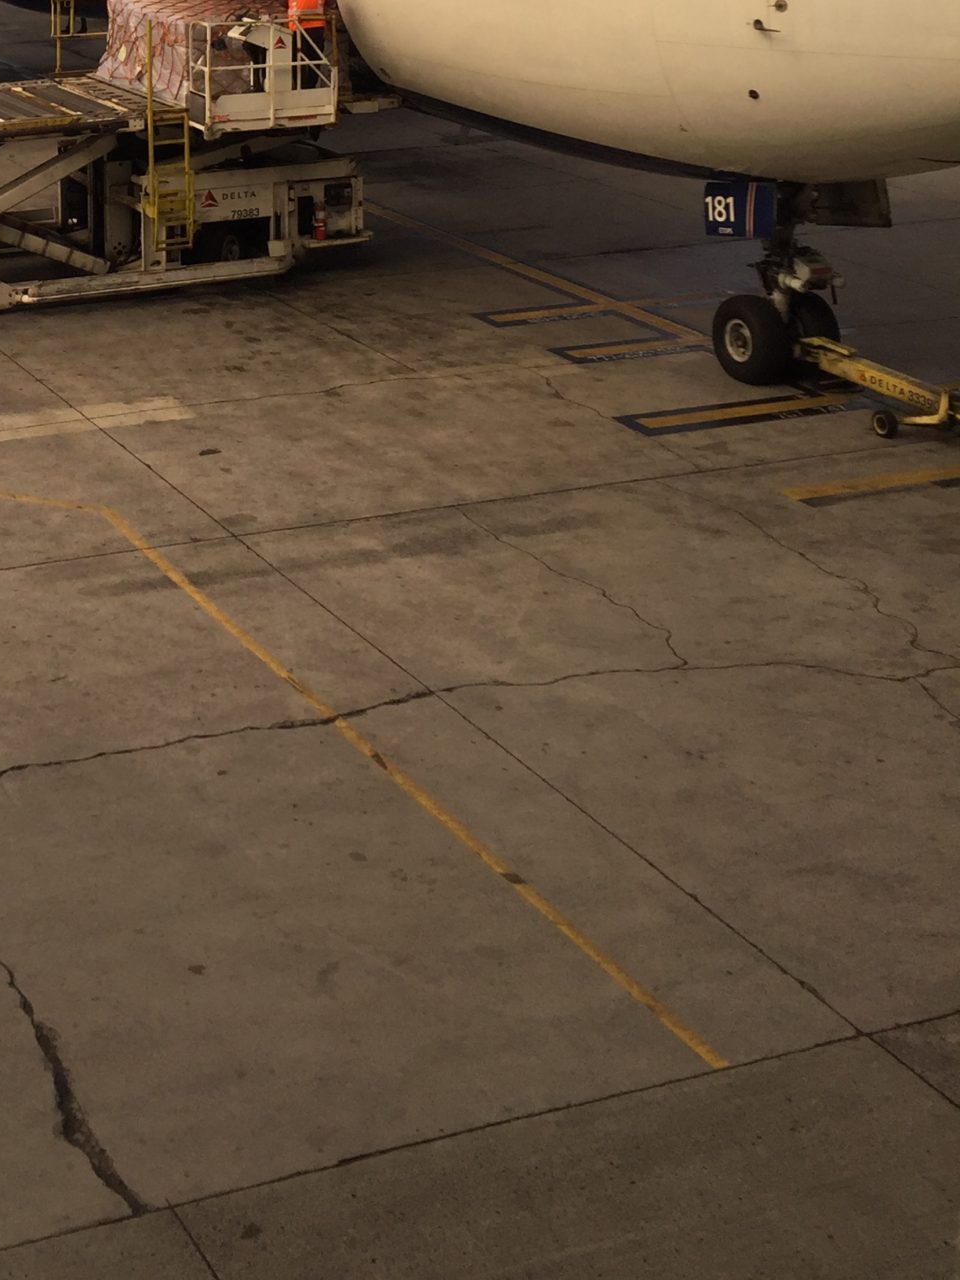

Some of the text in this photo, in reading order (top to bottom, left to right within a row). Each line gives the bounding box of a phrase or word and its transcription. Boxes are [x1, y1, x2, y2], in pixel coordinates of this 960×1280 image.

[222, 190, 257, 201] DELTA
[704, 196, 735, 222] 181
[870, 376, 906, 398] DELTA
